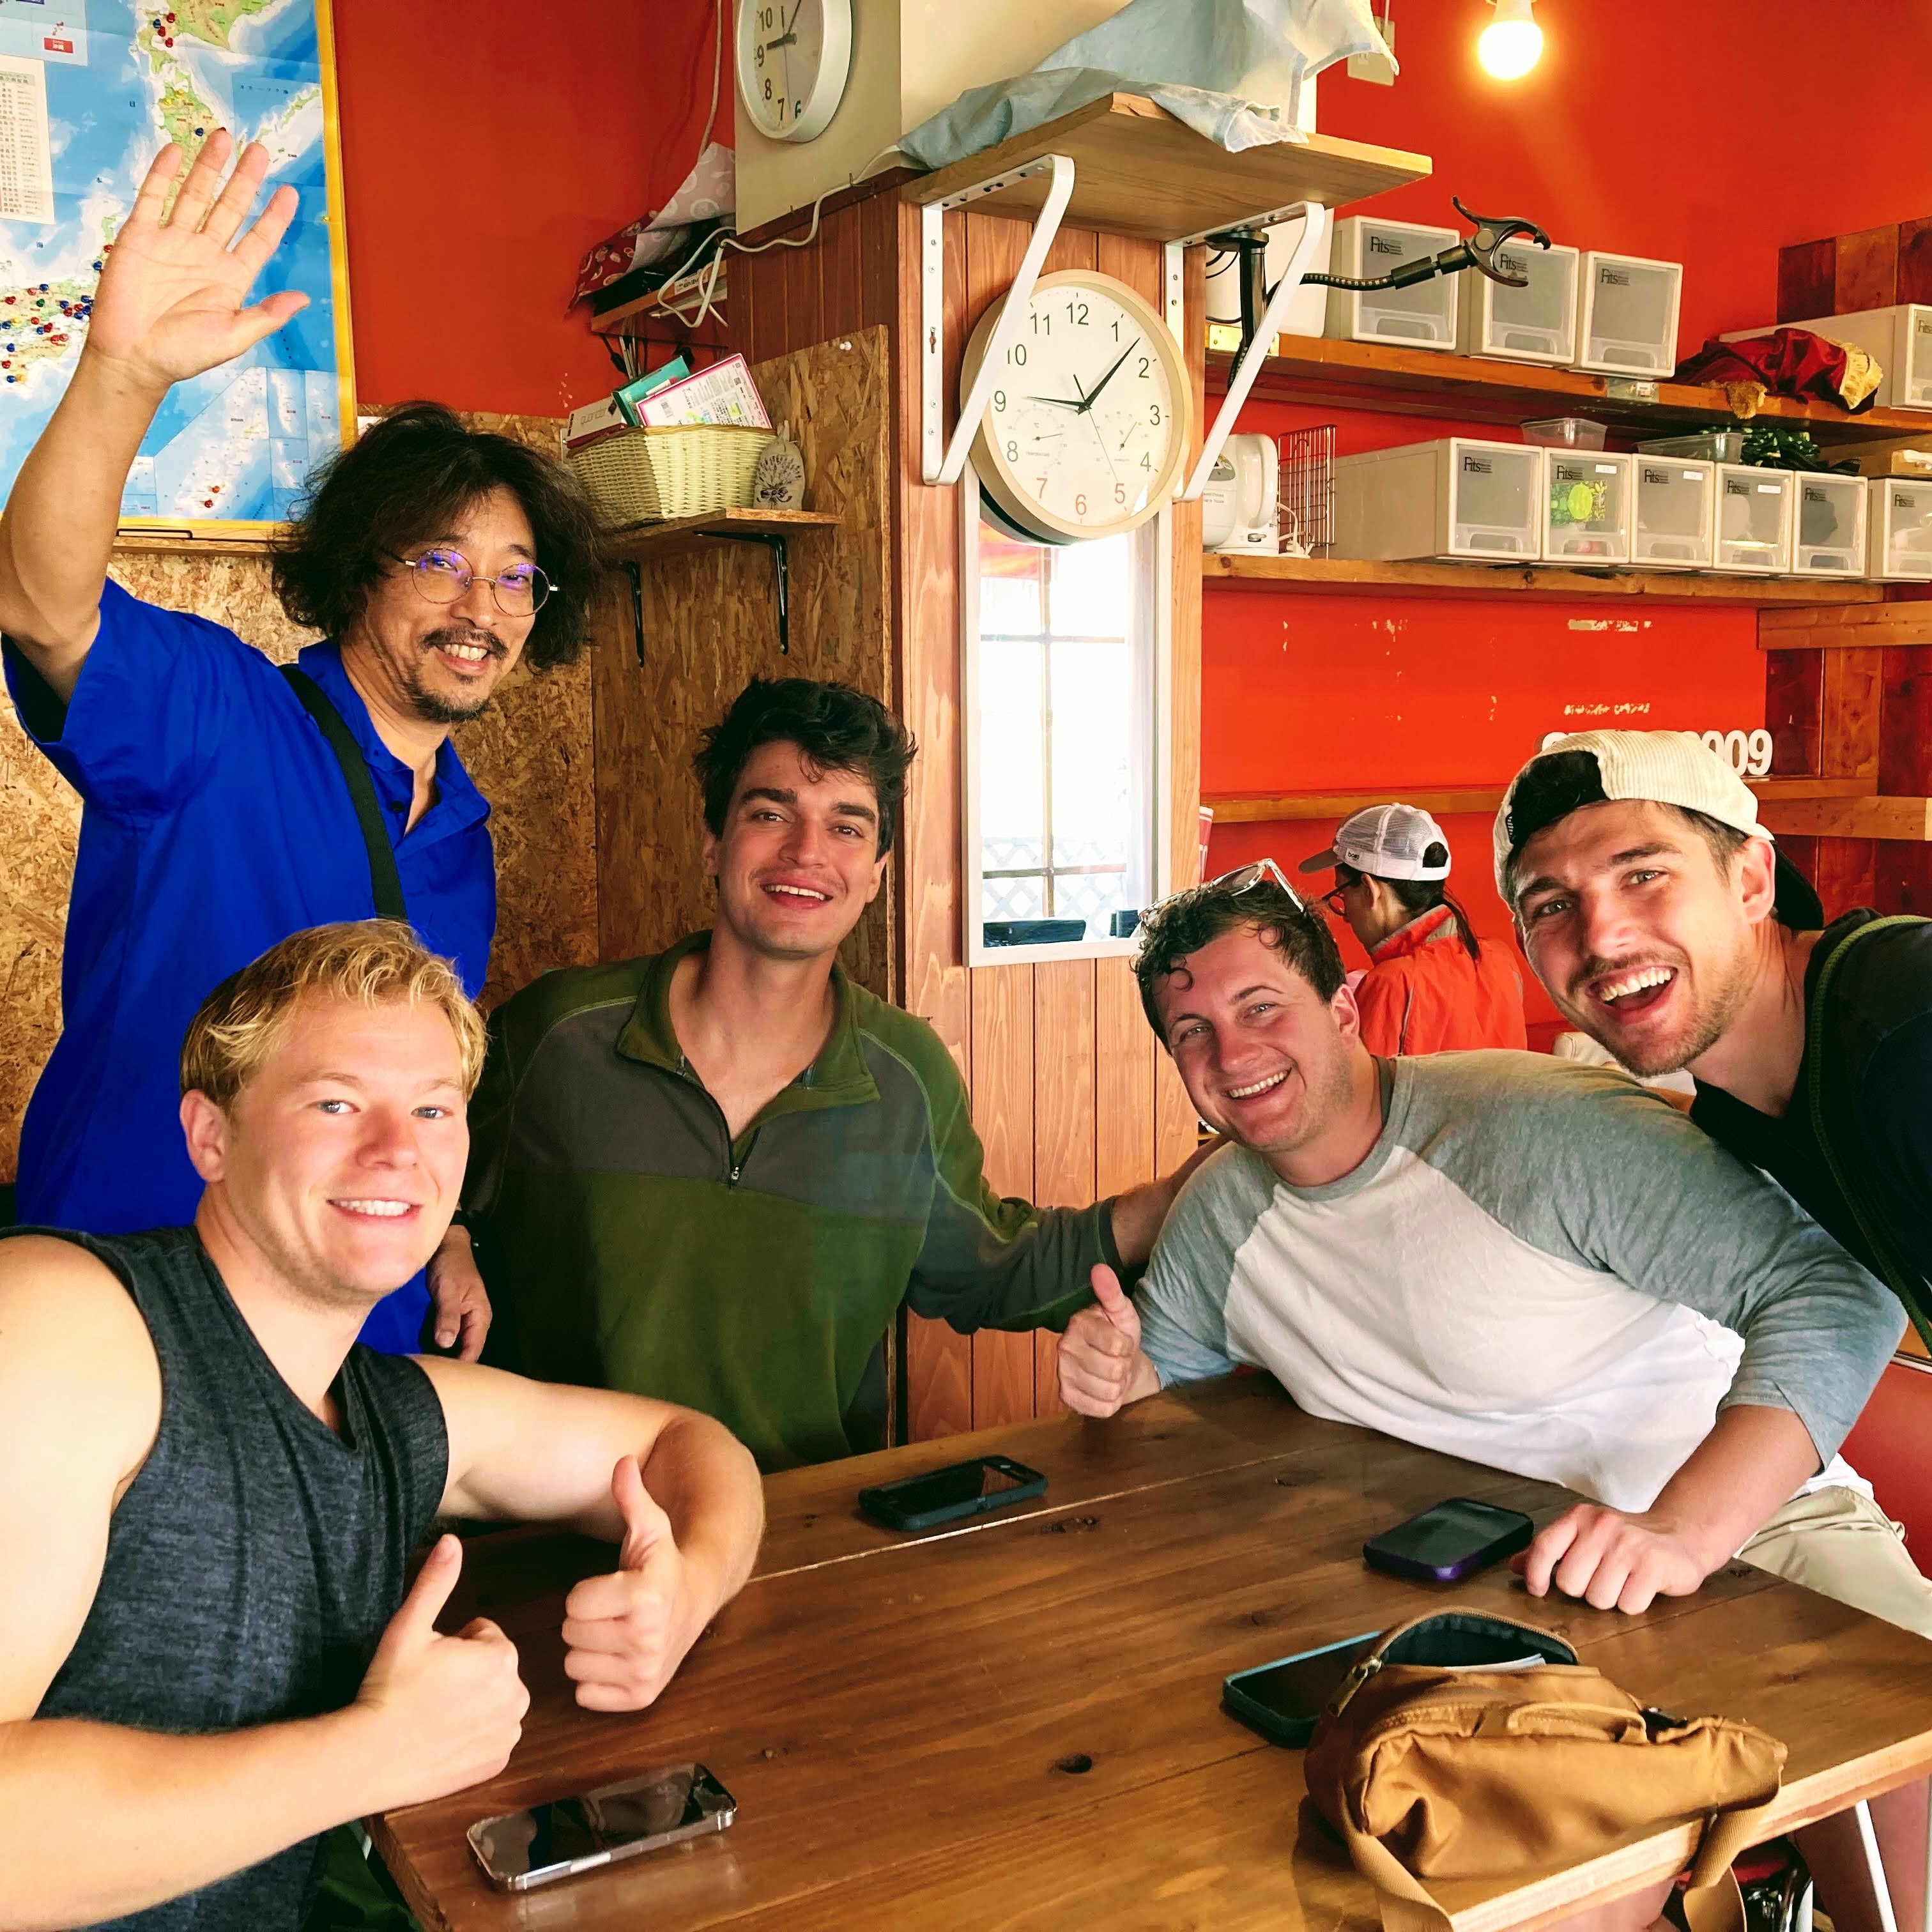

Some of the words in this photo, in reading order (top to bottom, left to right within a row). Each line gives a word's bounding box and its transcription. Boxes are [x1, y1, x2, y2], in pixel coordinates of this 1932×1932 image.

[758, 7, 773, 32] 10
[756, 45, 765, 68] 9
[764, 78, 772, 100] 8
[778, 98, 785, 121] 7
[1370, 236, 1390, 253] Fits
[1500, 254, 1517, 270] Fits
[1601, 268, 1618, 284] Fits
[1030, 312, 1050, 335] 11
[1066, 302, 1089, 326] 12
[1111, 321, 1118, 342] 1
[1007, 344, 1027, 366] 10
[1138, 357, 1149, 379] 2
[994, 390, 1006, 413] 9
[1149, 404, 1161, 427] 3
[1006, 440, 1019, 463] 8
[1140, 451, 1151, 473] 4
[1464, 456, 1482, 473] Fits
[1556, 464, 1574, 480] Fits
[1644, 469, 1660, 484] Fits
[1727, 480, 1741, 494] Fits
[1036, 477, 1048, 499] 7
[1114, 483, 1126, 504] 5
[1075, 494, 1087, 516] 6
